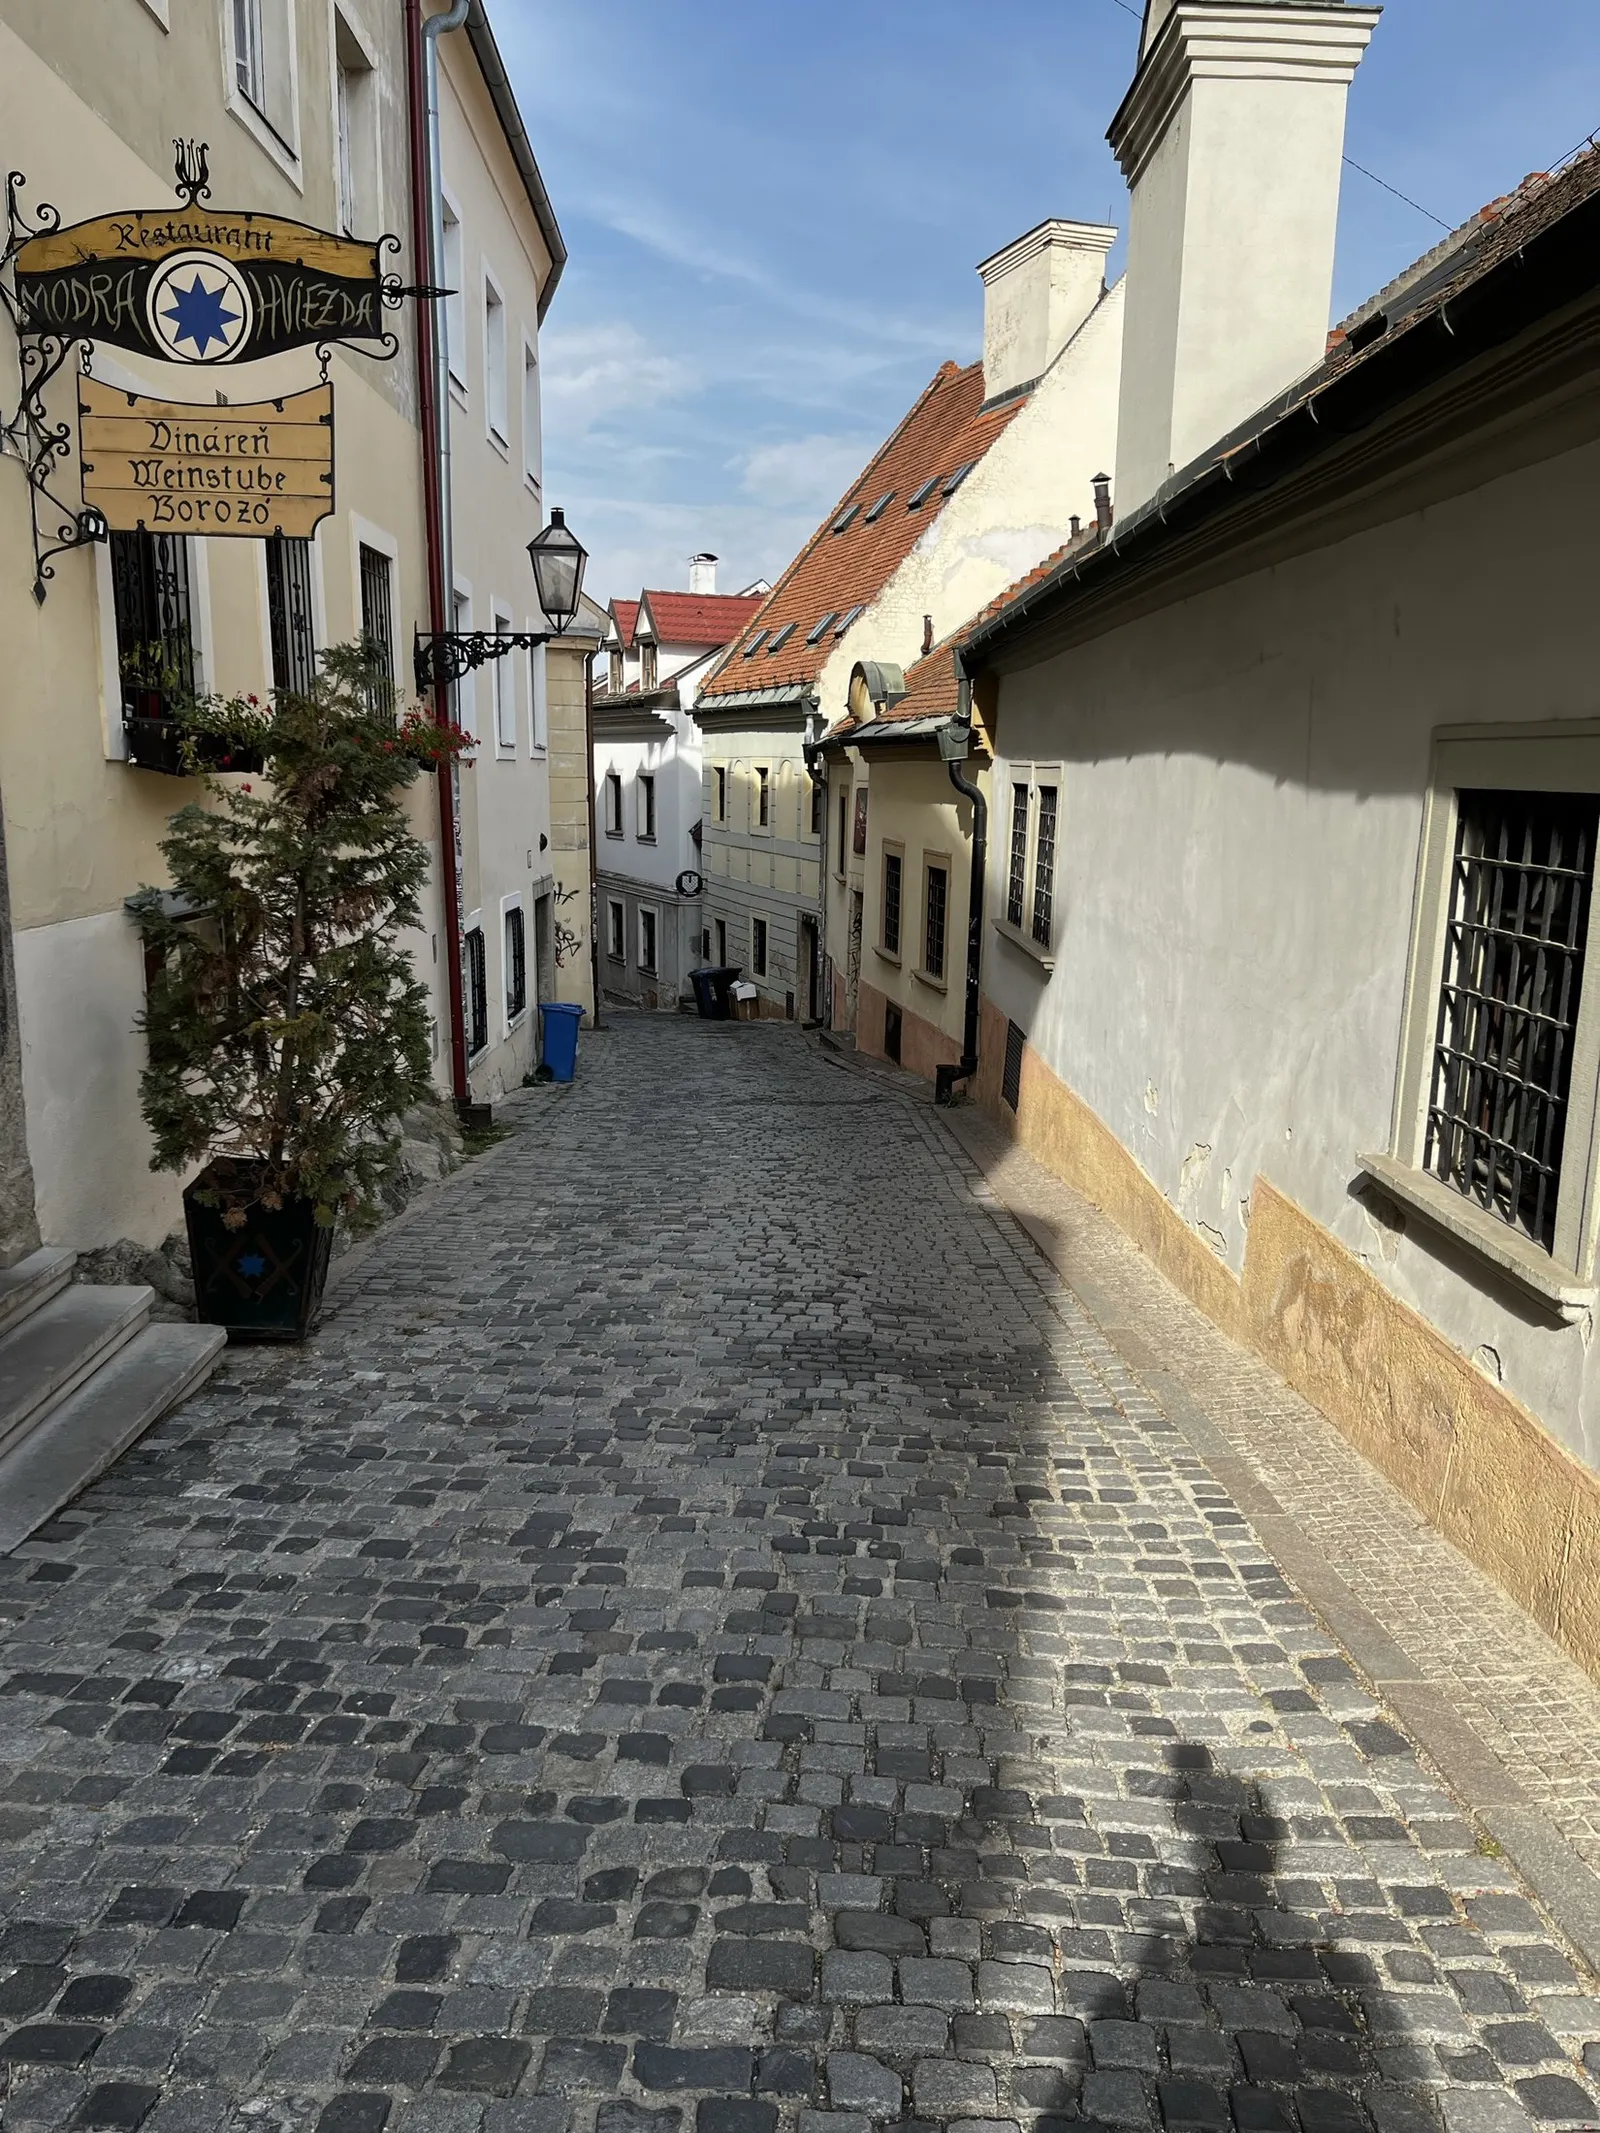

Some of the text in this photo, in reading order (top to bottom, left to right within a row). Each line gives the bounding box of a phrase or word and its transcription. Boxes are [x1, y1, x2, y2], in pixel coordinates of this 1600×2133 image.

[109, 221, 273, 254] Restaurant
[21, 268, 151, 347] MODRA
[128, 460, 286, 491] Weinstube
[148, 494, 271, 524] Borozó
